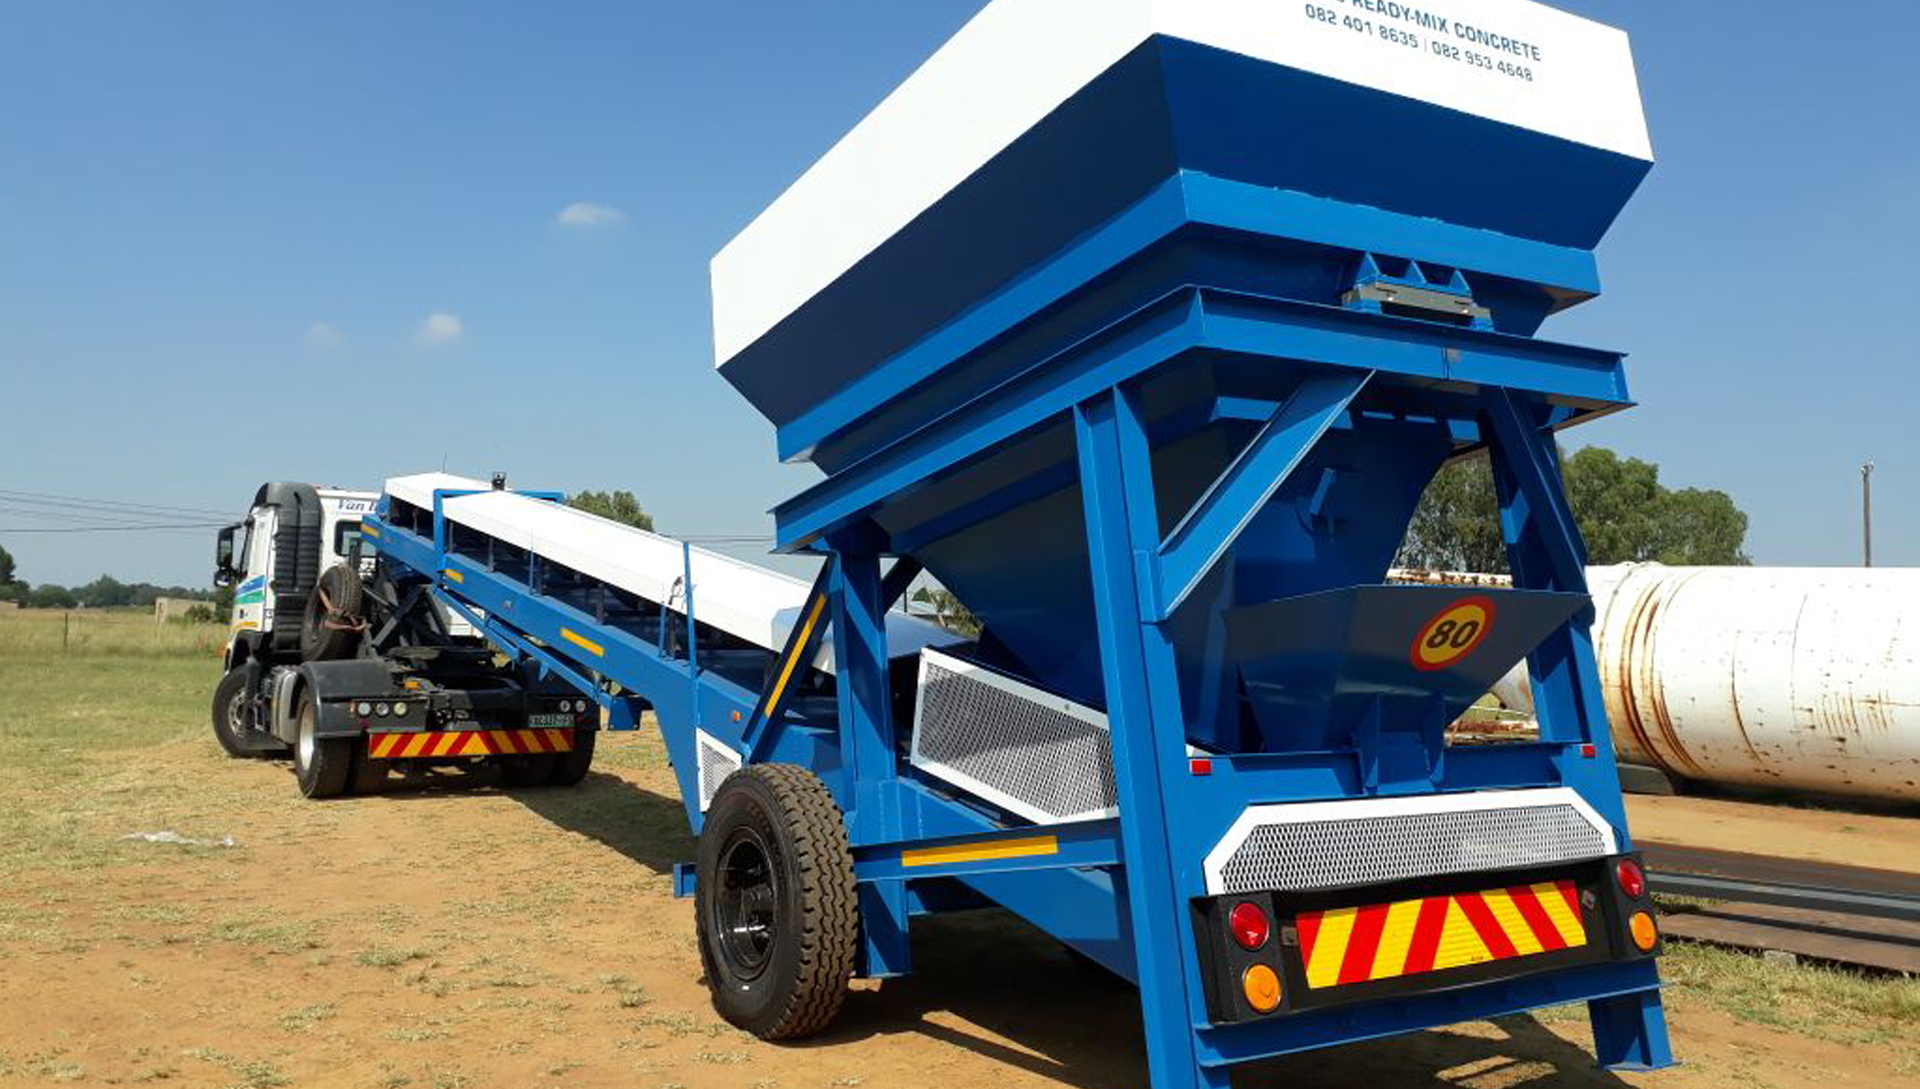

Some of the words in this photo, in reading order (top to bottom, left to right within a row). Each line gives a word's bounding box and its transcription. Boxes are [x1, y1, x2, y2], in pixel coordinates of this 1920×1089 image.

[1305, 3, 1337, 25] 082
[1343, 15, 1373, 35] 401
[1379, 24, 1418, 48] 8635
[1432, 41, 1461, 61] 082
[1465, 50, 1493, 70] 953
[1454, 22, 1541, 61] CONCRETE
[338, 499, 365, 511] Van
[1426, 620, 1479, 648] 80
